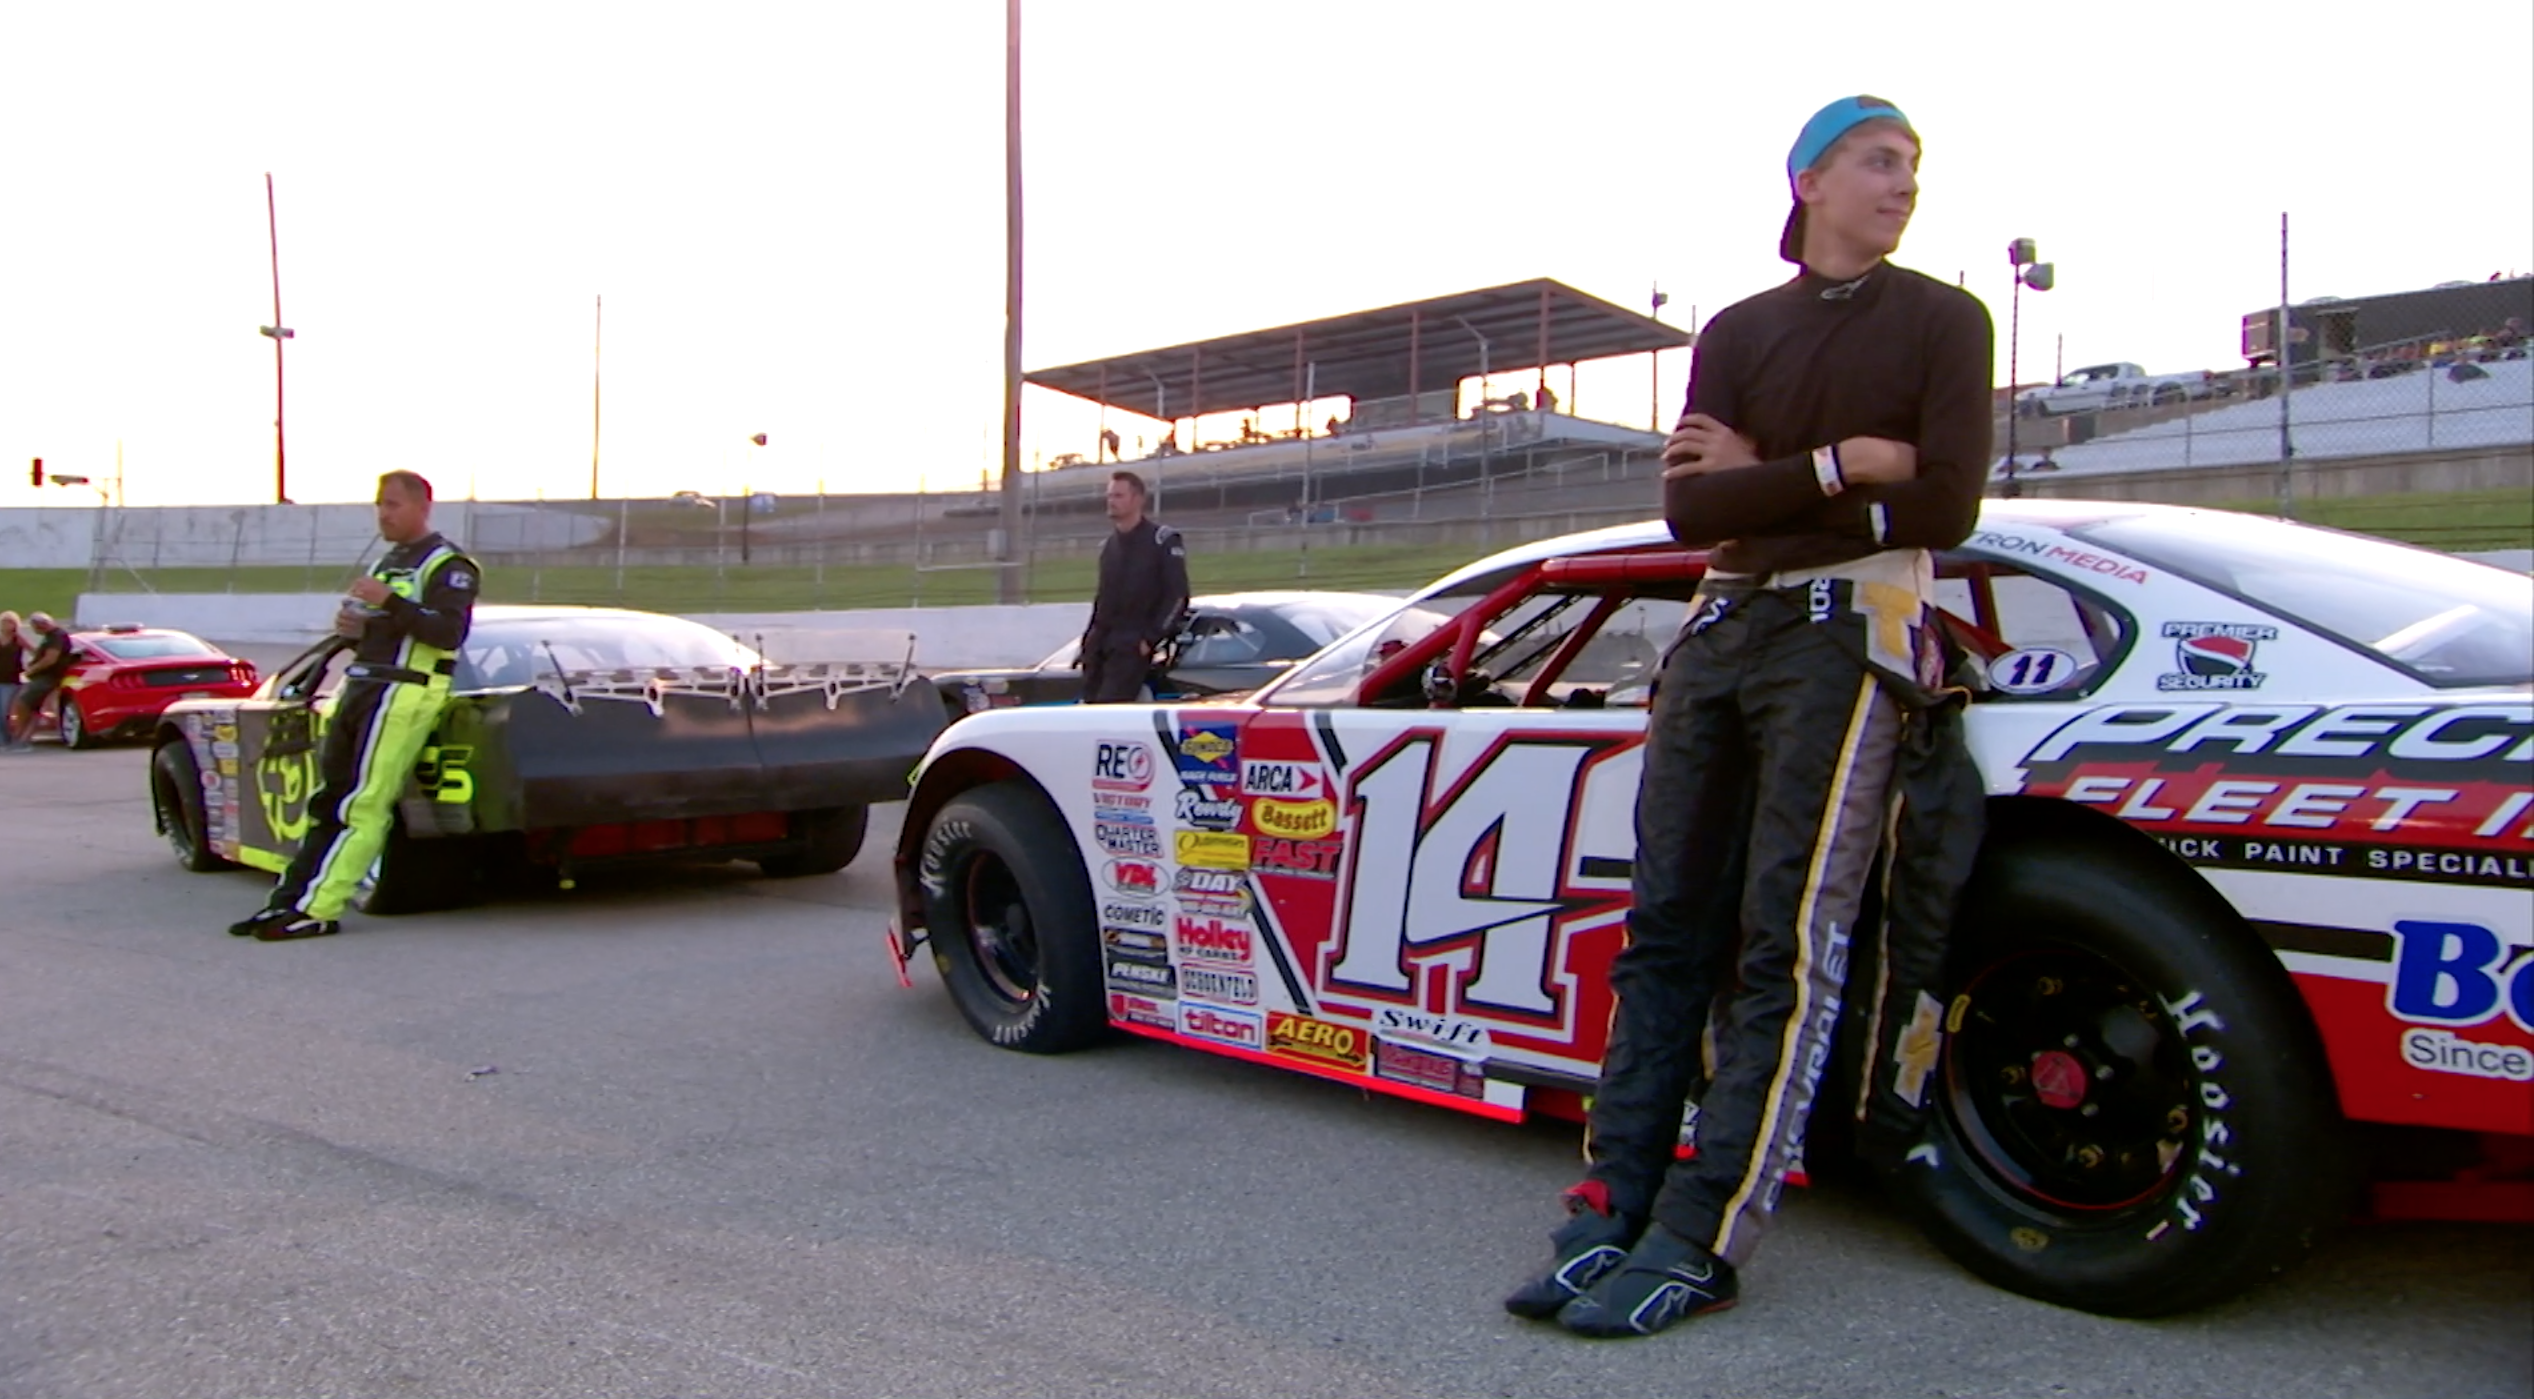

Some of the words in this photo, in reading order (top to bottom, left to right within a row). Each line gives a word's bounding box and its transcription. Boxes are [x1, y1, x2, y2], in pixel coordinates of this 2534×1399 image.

[2046, 545, 2149, 585] MEDIA
[2162, 622, 2278, 640] PREMIER
[2008, 653, 2057, 686] 11
[2157, 673, 2267, 691] SECURITY
[1245, 764, 1293, 792] ARCA
[1261, 805, 1328, 832] Bassett
[2066, 776, 2460, 832] FLEET
[1253, 839, 1343, 872] FAST
[2244, 842, 2345, 865] PAINT
[1328, 735, 1592, 1018] 14
[1177, 917, 1251, 961] Holley
[1184, 1008, 1255, 1042] tilton
[1272, 1016, 1355, 1055] AERO
[1379, 1008, 1486, 1044] Swift
[2408, 1033, 2528, 1076] Since
[2156, 989, 2243, 1231] Hoosier
